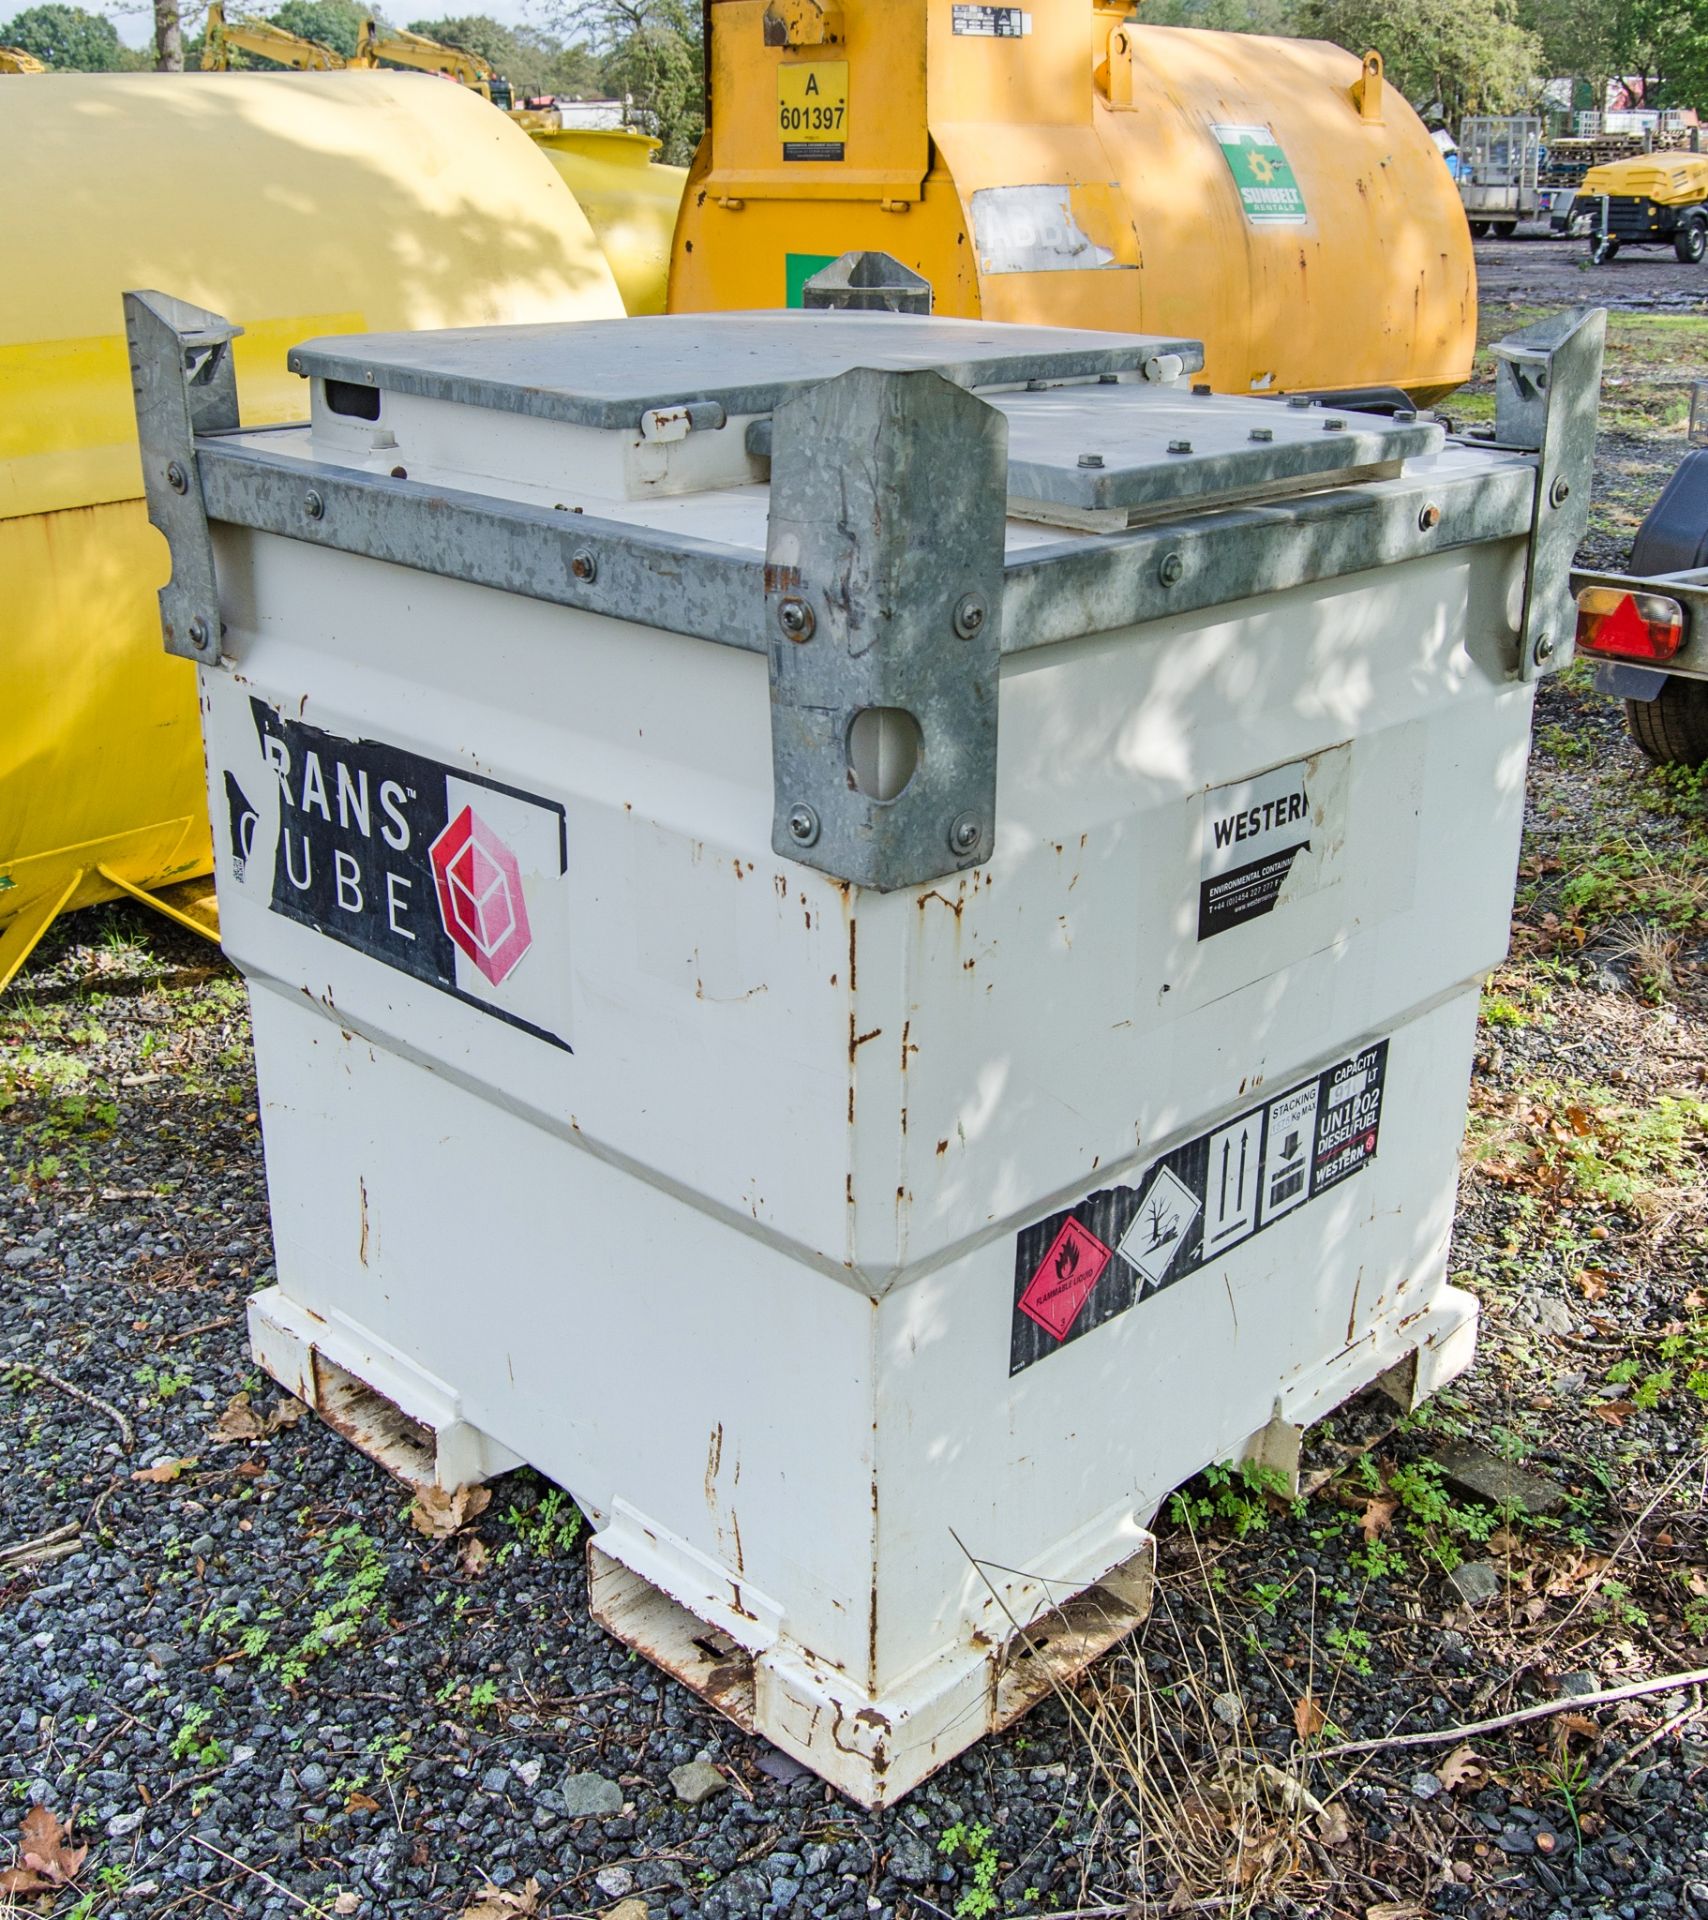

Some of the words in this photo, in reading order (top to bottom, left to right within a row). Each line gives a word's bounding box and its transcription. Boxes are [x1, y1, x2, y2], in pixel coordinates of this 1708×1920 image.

[805, 73, 819, 96] A
[781, 106, 844, 130] 601397
[1240, 187, 1299, 204] SUNBELT
[1209, 870, 1261, 897] ENVIRONMENTAL
[1334, 1050, 1378, 1084] CAPACITY
[1367, 1067, 1379, 1083] LT
[1272, 1088, 1316, 1120] STACKING
[1302, 1102, 1316, 1116] MAX
[1320, 1087, 1381, 1137] UN1202
[1317, 1125, 1352, 1155] DIESEL
[1353, 1110, 1378, 1135] FUEL
[1036, 1281, 1073, 1306] FLAMMABLE
[1073, 1268, 1094, 1286] LIQUID
[1060, 1317, 1066, 1328] 3
